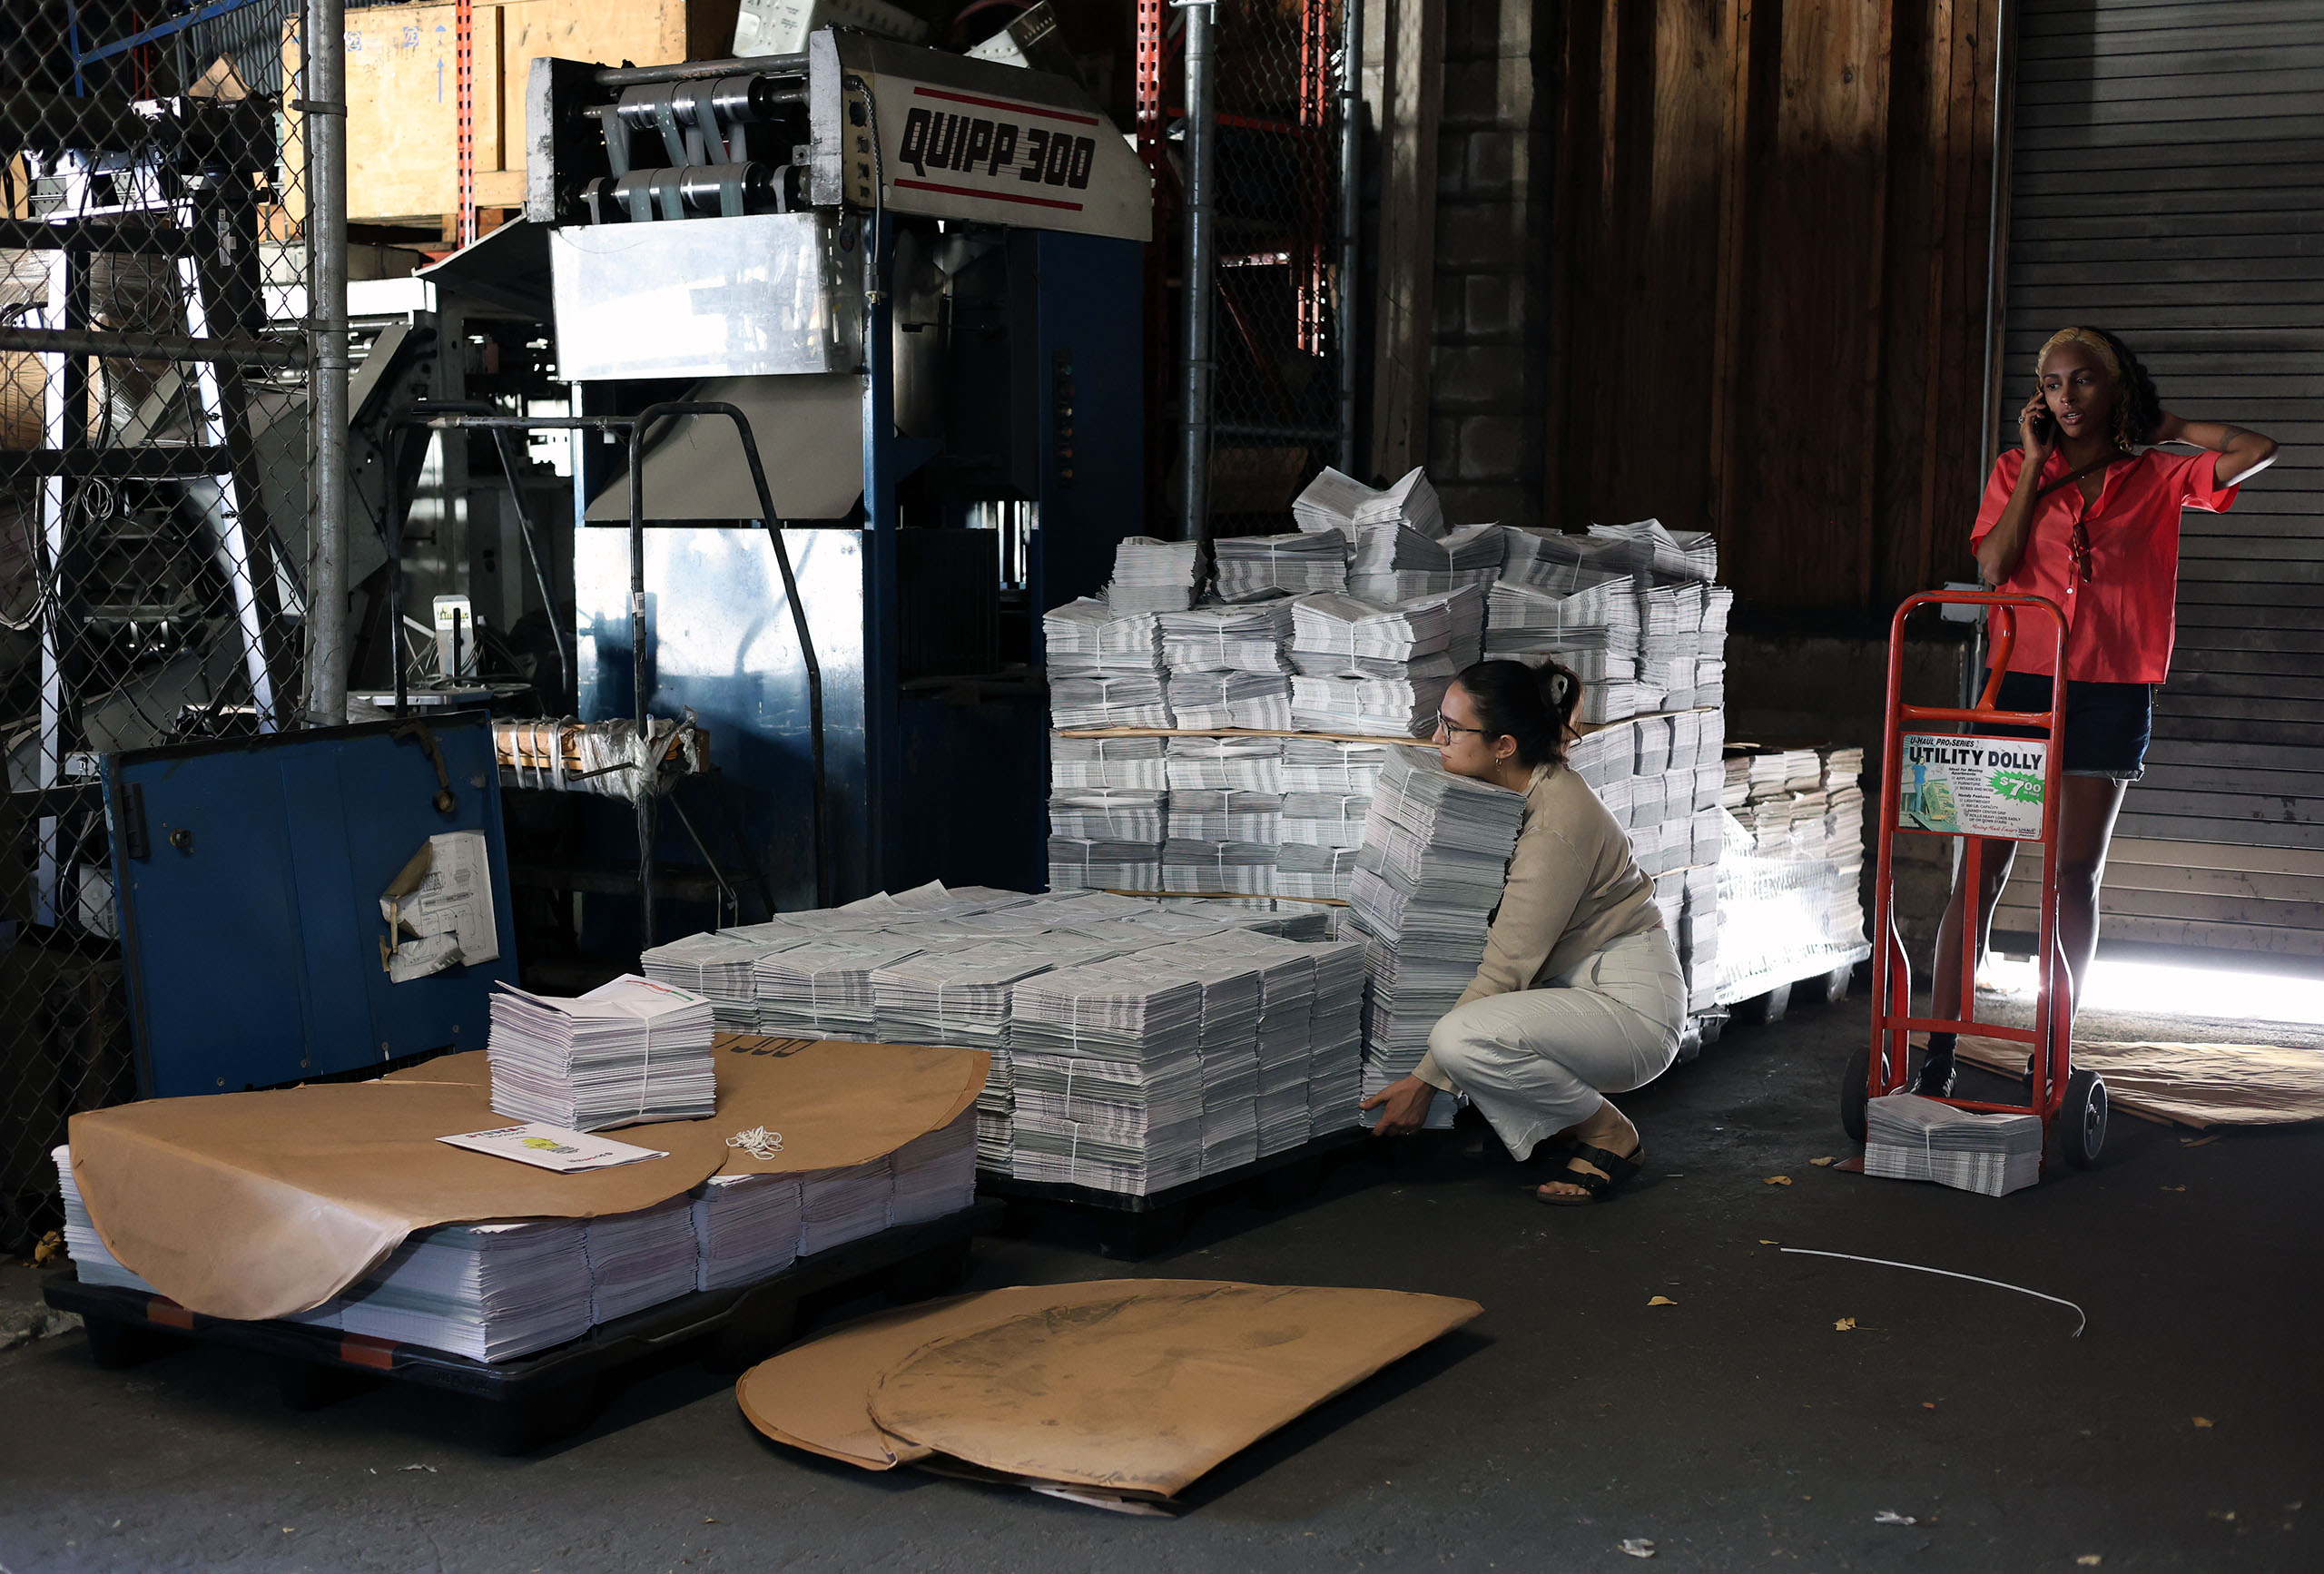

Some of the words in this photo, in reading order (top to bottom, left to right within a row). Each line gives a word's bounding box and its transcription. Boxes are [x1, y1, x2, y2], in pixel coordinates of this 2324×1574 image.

[899, 107, 1019, 177] QUIPP
[1019, 128, 1096, 190] 300
[1909, 746, 1984, 766] UTILITY
[1988, 751, 2043, 770] DOLLY
